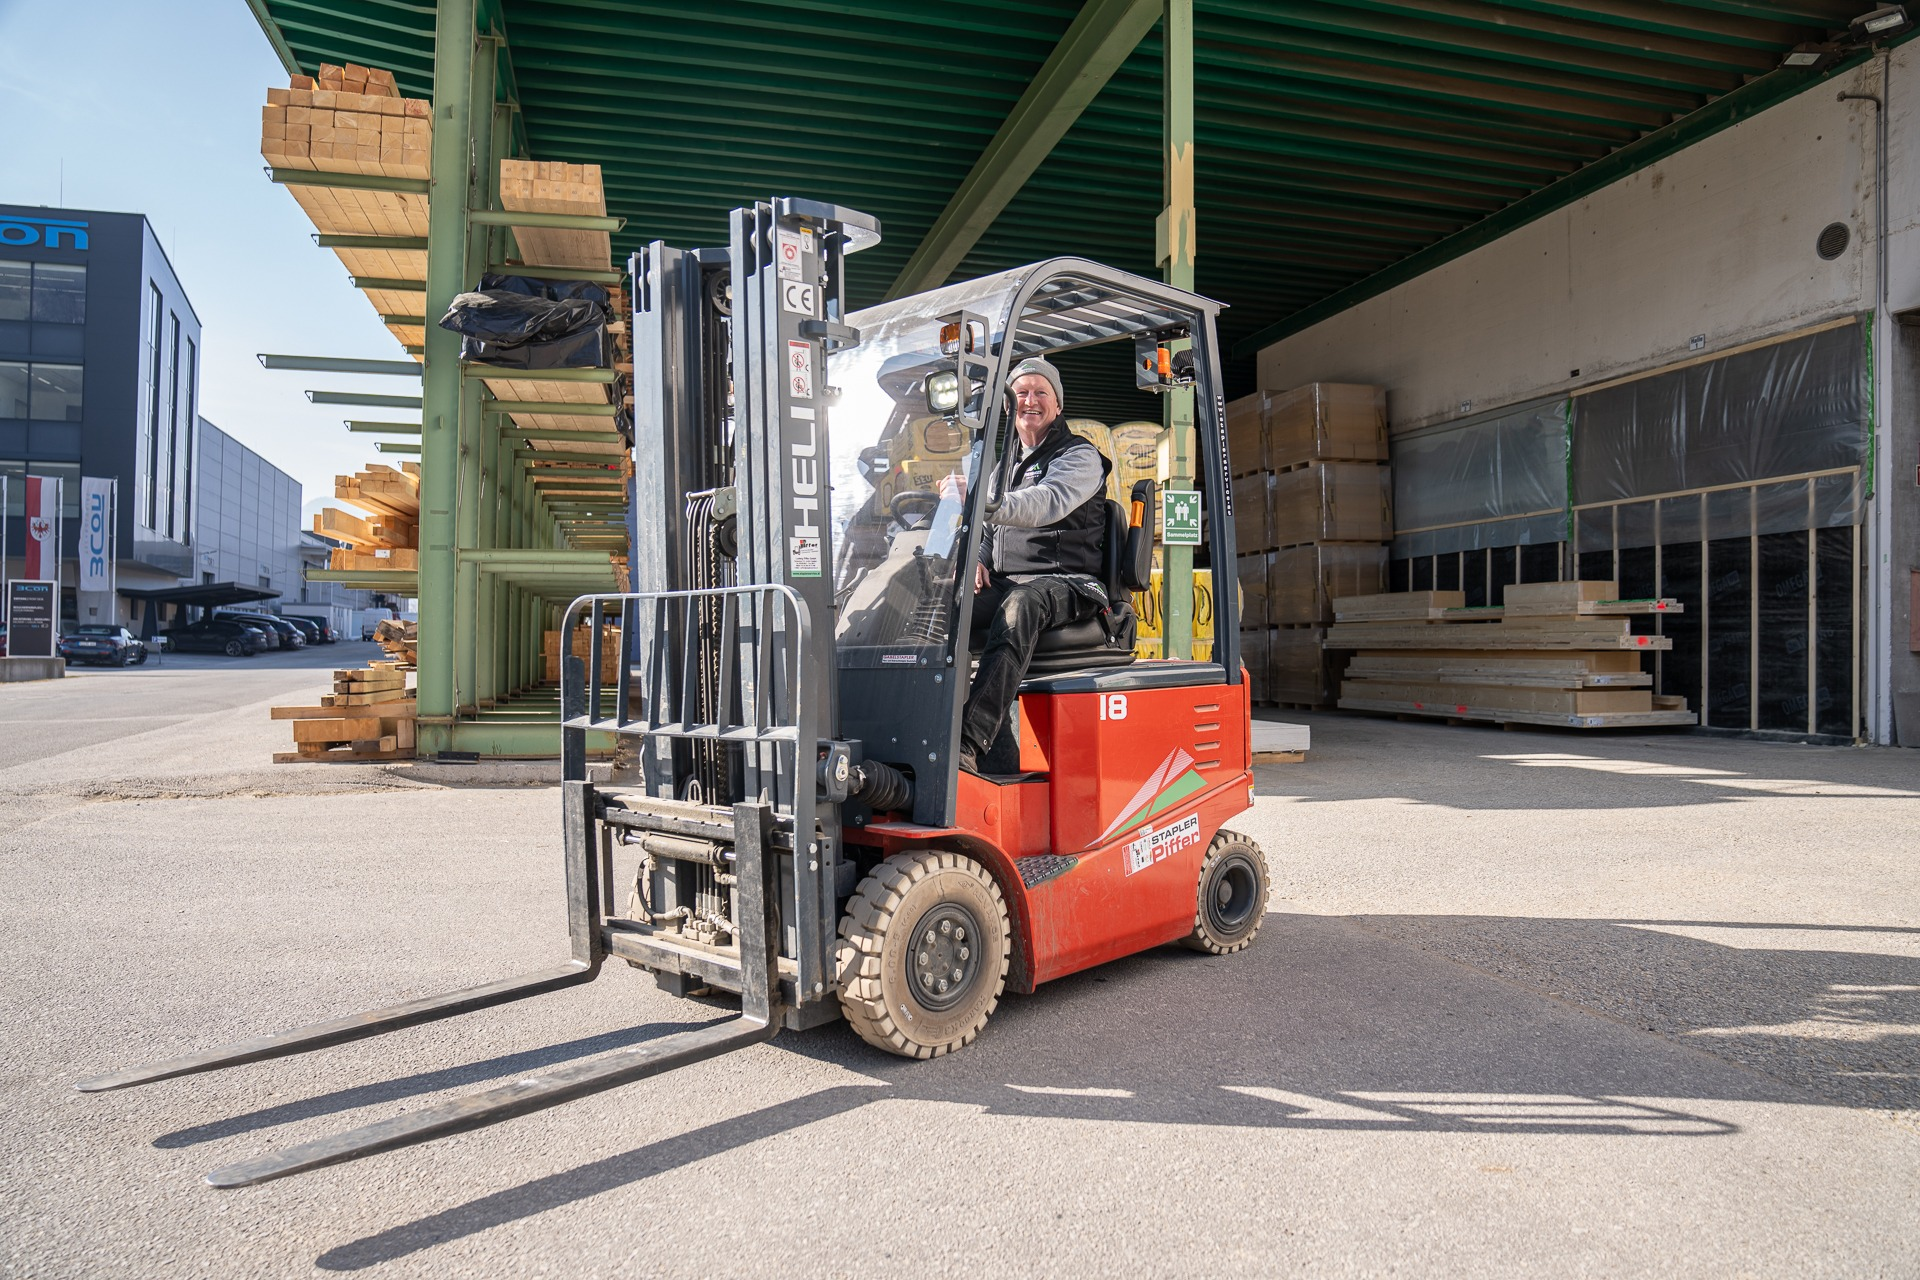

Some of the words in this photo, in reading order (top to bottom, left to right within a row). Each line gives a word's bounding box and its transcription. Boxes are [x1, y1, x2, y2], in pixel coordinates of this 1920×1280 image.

[786, 285, 812, 312] CE
[790, 405, 820, 538] HELI
[1166, 531, 1198, 541] Sammelplatz
[1099, 694, 1128, 721] 18
[1151, 816, 1198, 846] STAPLER
[1151, 830, 1200, 864] Piffer
